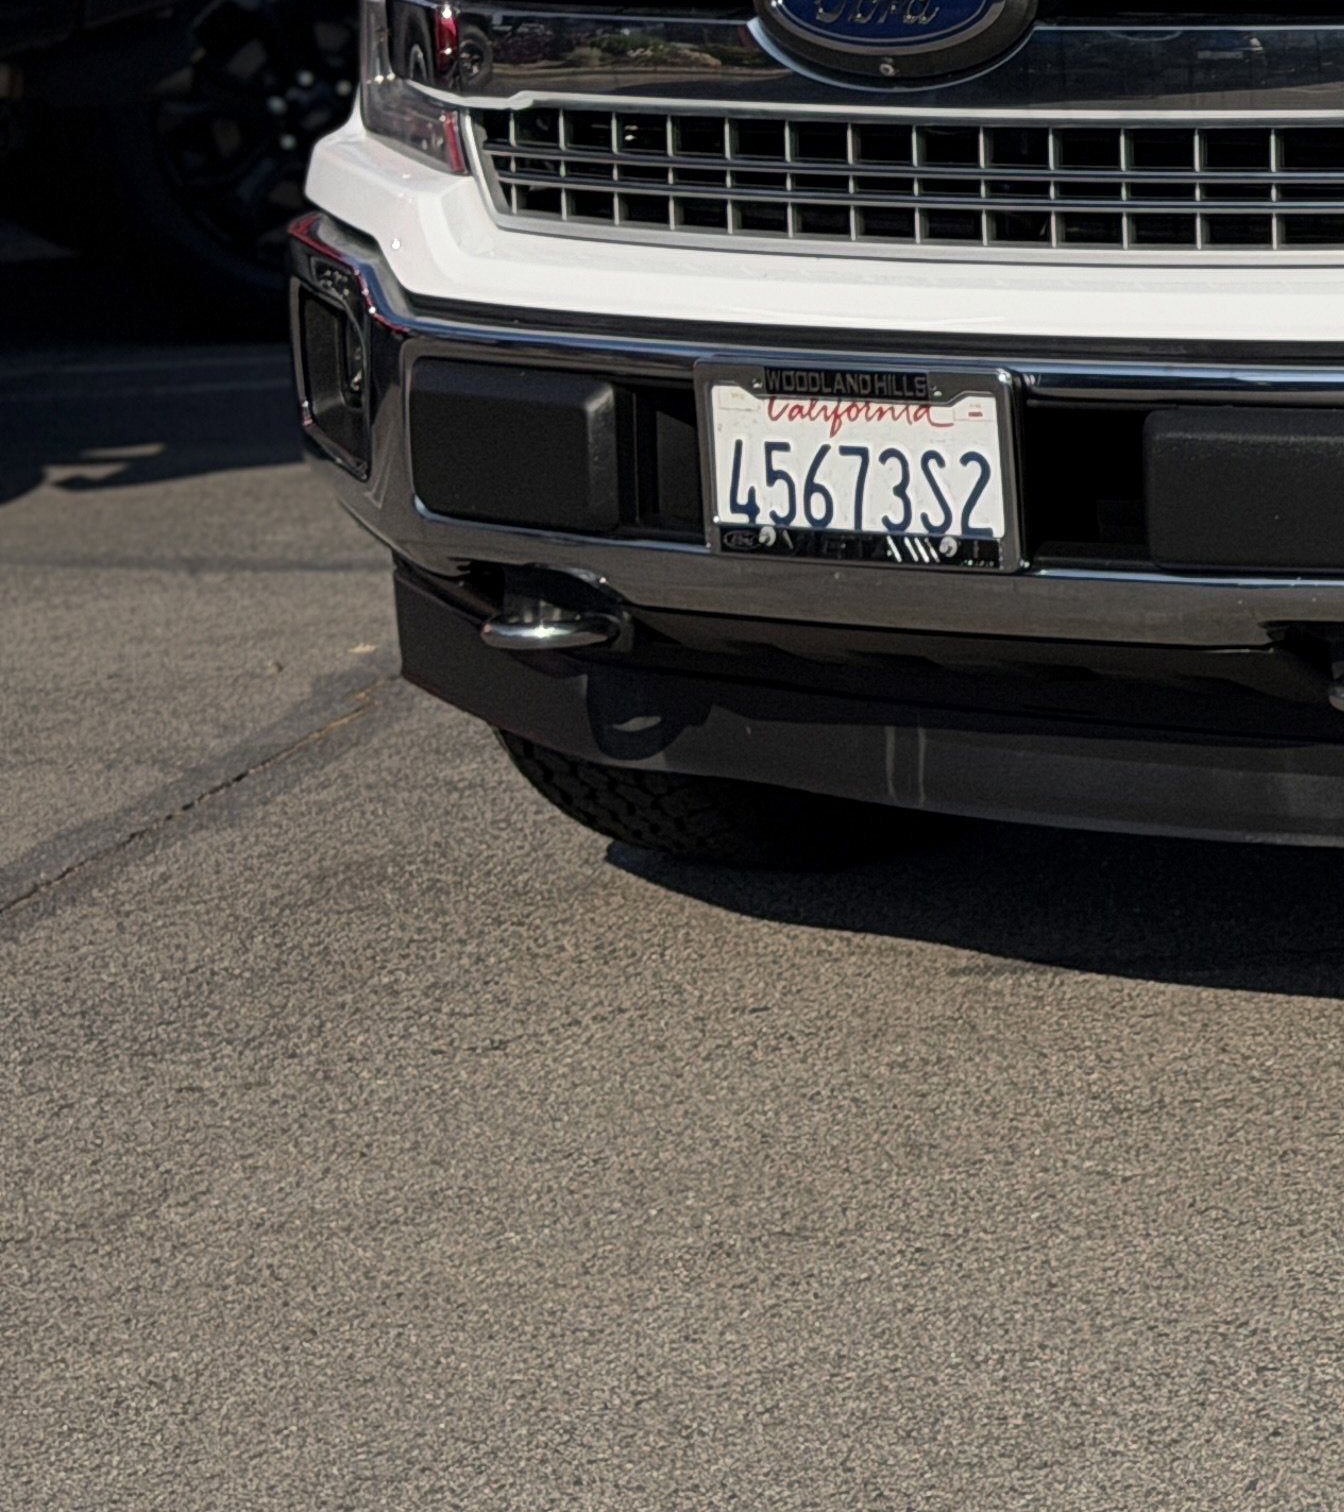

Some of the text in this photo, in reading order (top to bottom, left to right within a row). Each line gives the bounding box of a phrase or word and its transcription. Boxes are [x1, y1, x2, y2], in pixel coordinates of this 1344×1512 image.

[767, 368, 928, 397] WOODLAND HILLS
[767, 396, 954, 437] California
[729, 439, 993, 537] 45673S2
